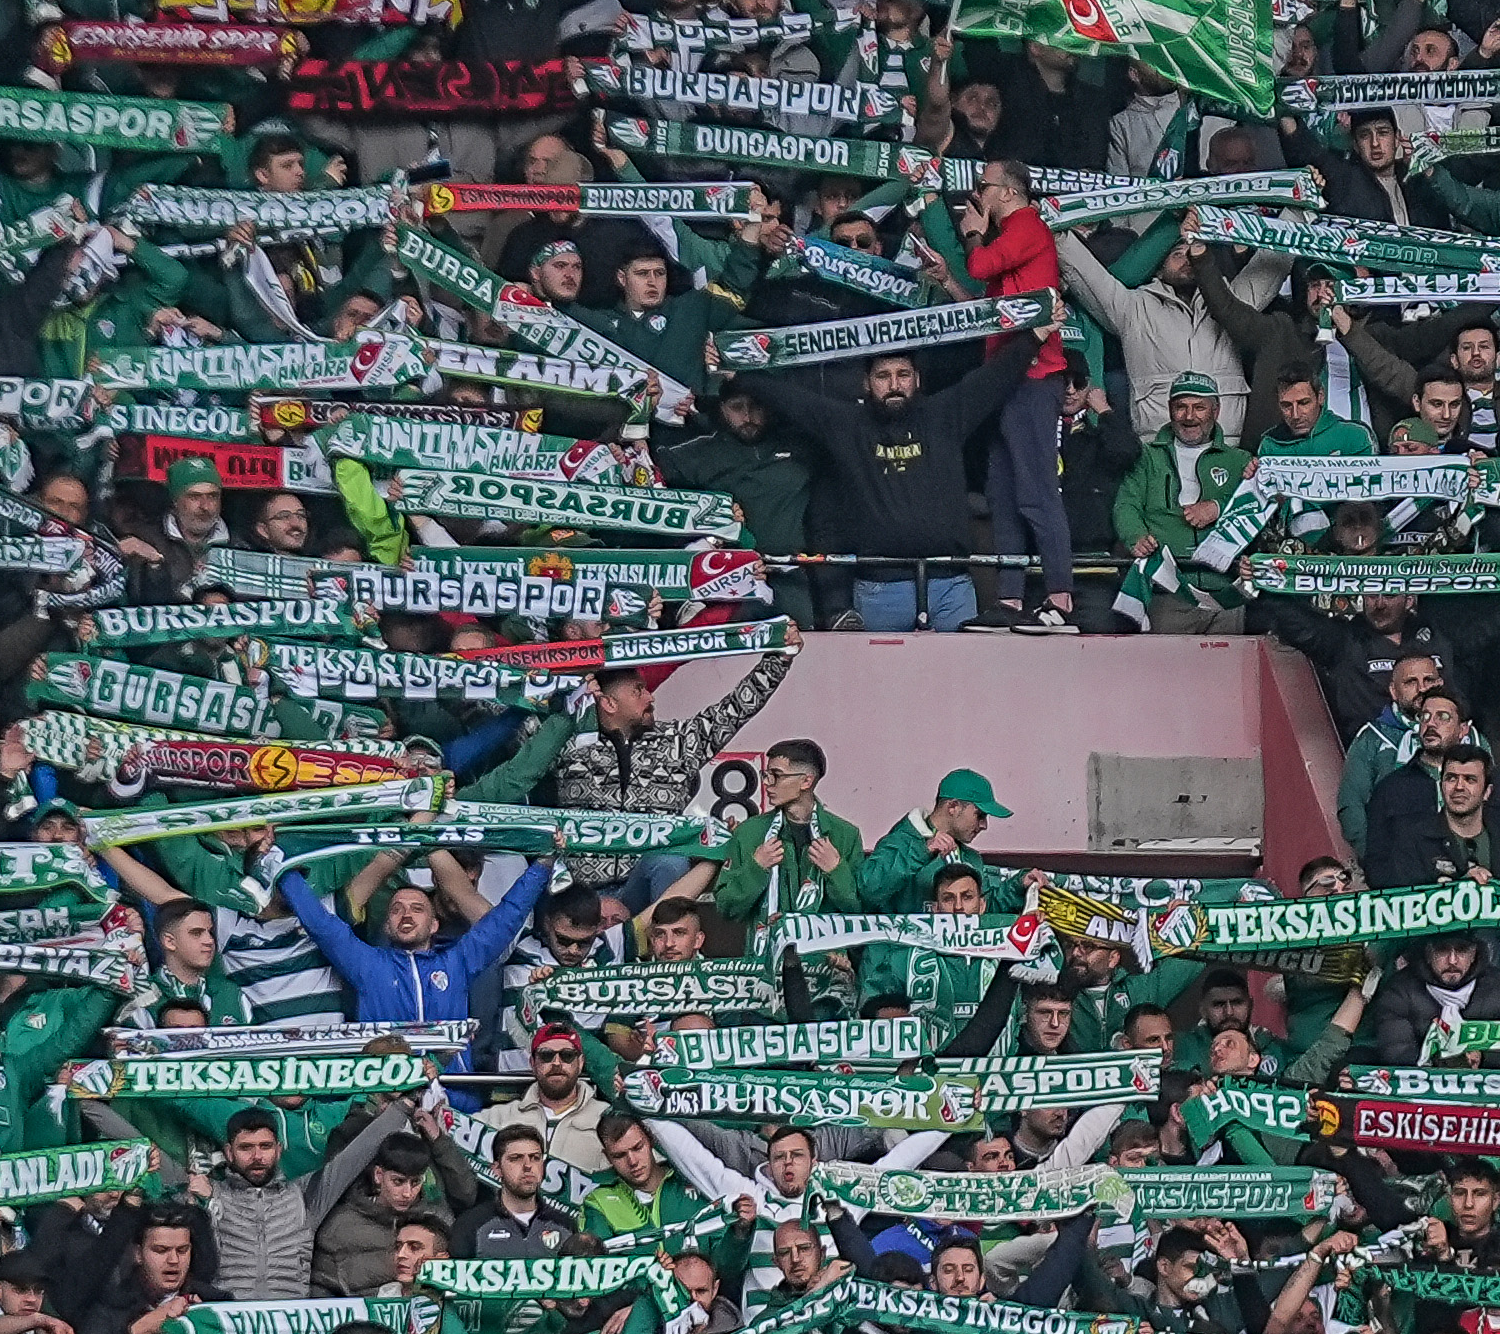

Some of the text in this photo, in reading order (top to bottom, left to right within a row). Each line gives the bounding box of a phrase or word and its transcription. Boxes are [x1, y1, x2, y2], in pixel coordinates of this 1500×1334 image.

[626, 66, 862, 116] BURSASPOR
[587, 186, 695, 211] BURSASPOR
[806, 245, 920, 298] Bursaspor
[785, 321, 861, 355] SENDEN
[490, 451, 559, 474] ANKARA
[1293, 575, 1500, 594] BURSASPOR
[1296, 557, 1333, 576] Seni
[1335, 557, 1396, 576] Annem
[1399, 557, 1436, 576] Gibi
[353, 570, 606, 617] BURSASPOR
[102, 599, 342, 639] BURSASPOR
[610, 631, 729, 659] BURSASPOR
[675, 1017, 922, 1067] BURSASPOR
[701, 1085, 930, 1124] BURSASPOR
